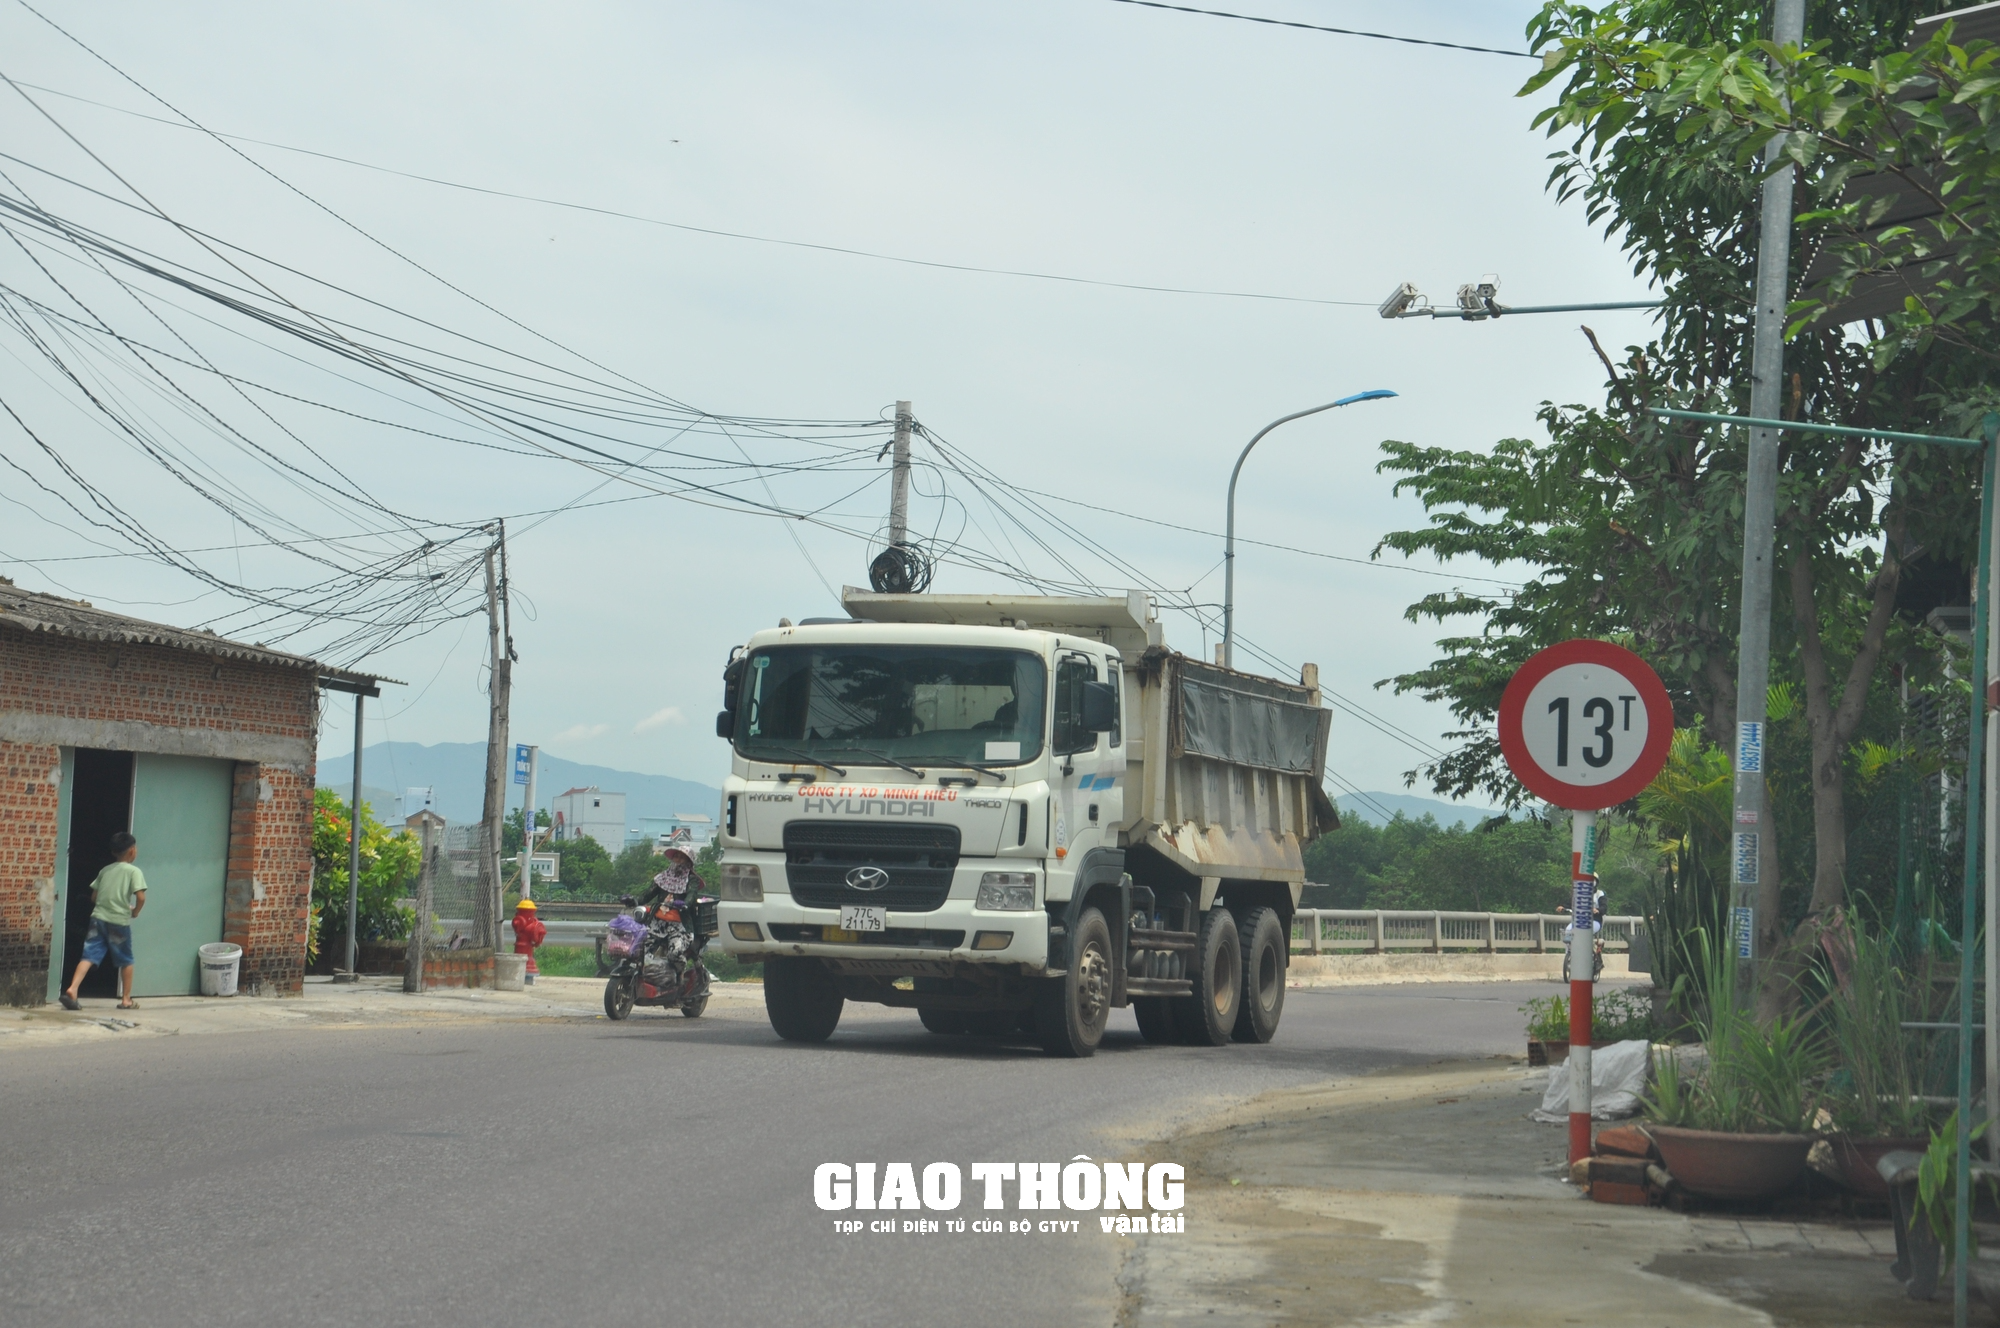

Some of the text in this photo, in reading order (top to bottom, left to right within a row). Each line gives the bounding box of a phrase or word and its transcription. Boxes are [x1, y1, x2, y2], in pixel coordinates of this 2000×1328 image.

[1740, 723, 1760, 771] 0983724444
[749, 792, 794, 803] HYUNDAI
[798, 784, 835, 798] CÔNG
[839, 786, 856, 798] TY
[859, 787, 879, 799] XD
[883, 788, 919, 800] MINH
[804, 798, 935, 817] HYUNDAI
[1738, 833, 1757, 883] 0905316222
[1577, 882, 1593, 896] 032
[1576, 896, 1592, 910] 033
[854, 907, 873, 919] 77C
[1575, 911, 1592, 930] 0985
[845, 918, 881, 930] 211.79
